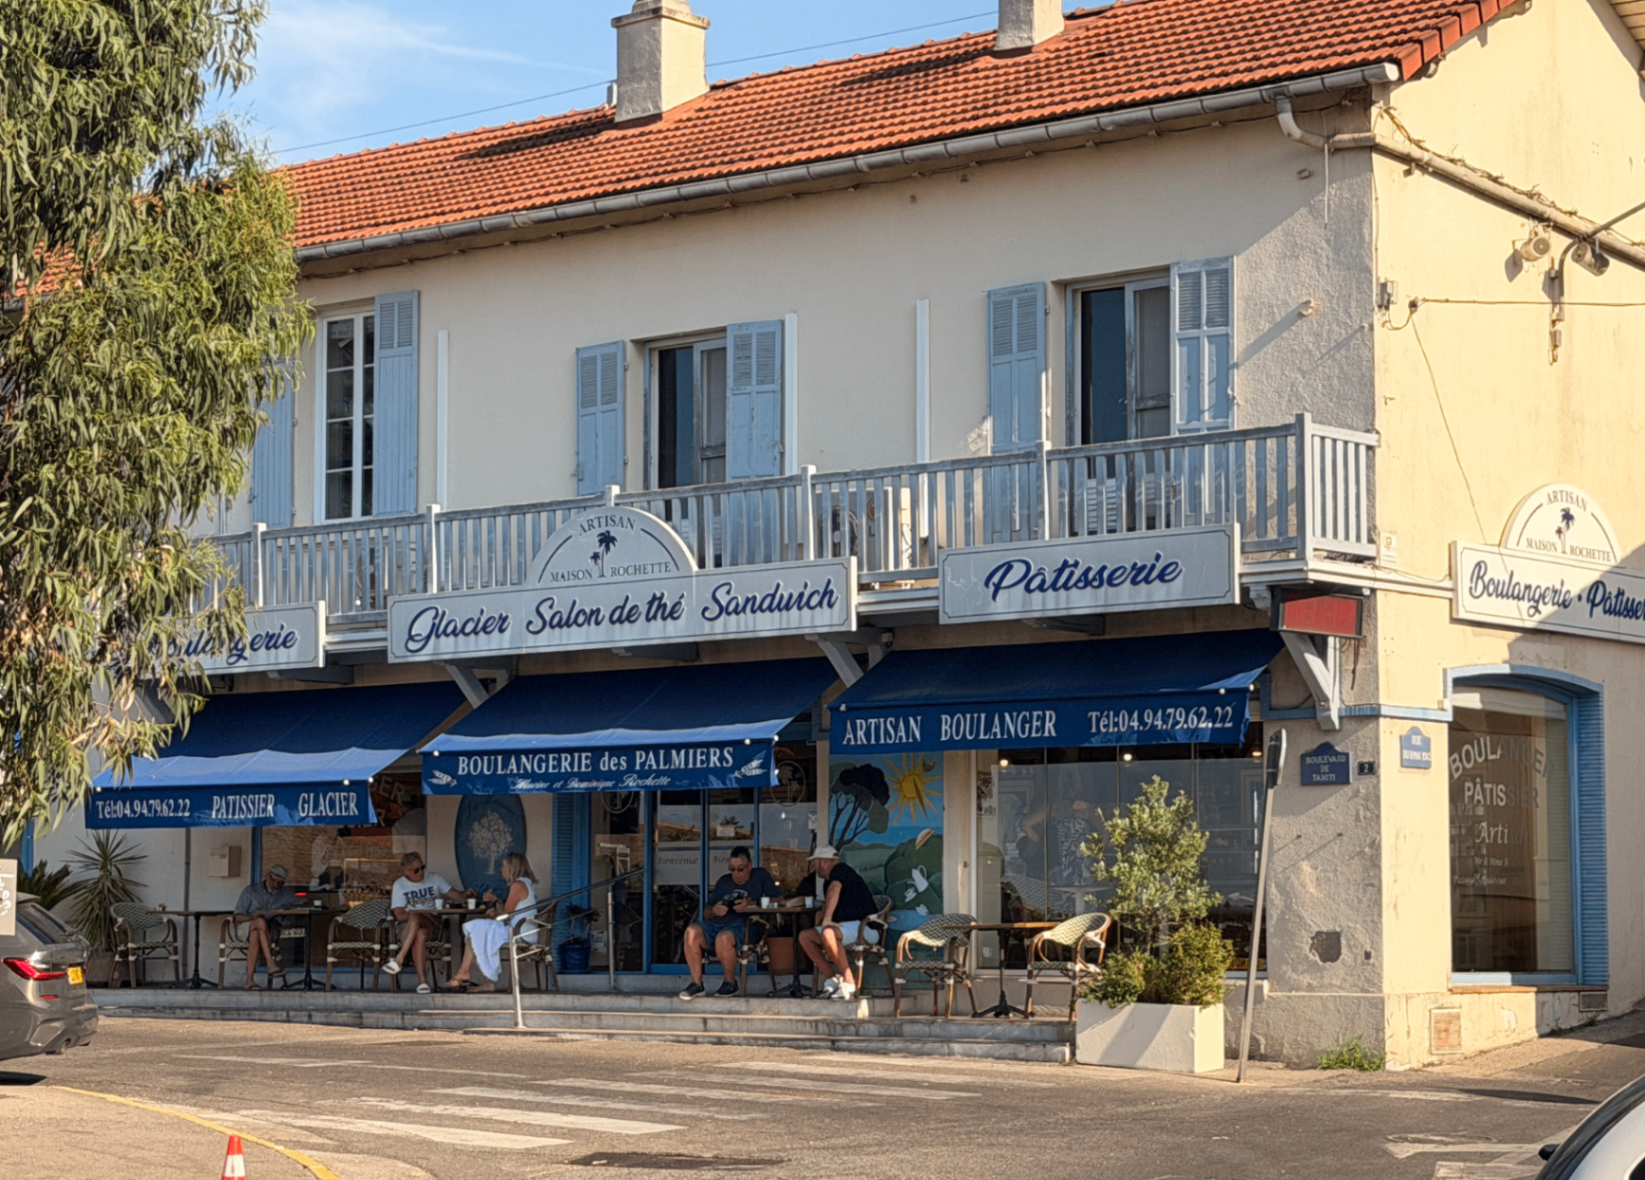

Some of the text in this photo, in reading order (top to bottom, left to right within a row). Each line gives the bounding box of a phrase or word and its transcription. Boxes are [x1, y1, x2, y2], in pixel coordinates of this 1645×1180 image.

[1546, 489, 1588, 512] ARTISAN
[577, 514, 636, 536] ARTISAN
[1526, 537, 1611, 562] MAISON ROCHETTE
[549, 560, 672, 583] MAISON ROCHETTE
[984, 550, 1183, 602] Pâtisserie
[1469, 560, 1645, 622] Boulangerie Pâtisse
[404, 577, 838, 653] Glacier Salon de thé Sandwich
[842, 706, 1233, 745] ARTISAN BOULANGER Tél:04.94.79.62.22
[458, 747, 734, 776] BOULANGERIE des PALMIERS
[1306, 754, 1346, 764] BOULEVARD
[1363, 763, 1369, 773] 2
[566, 777, 615, 790] Dominique
[618, 773, 671, 788] Rochette
[1312, 773, 1336, 782] TAHITI
[96, 792, 358, 819] Tél:04.94.79.62.22 PATISSIER GLACIER
[1475, 821, 1524, 844] Arti
[403, 886, 436, 900] TRUE
